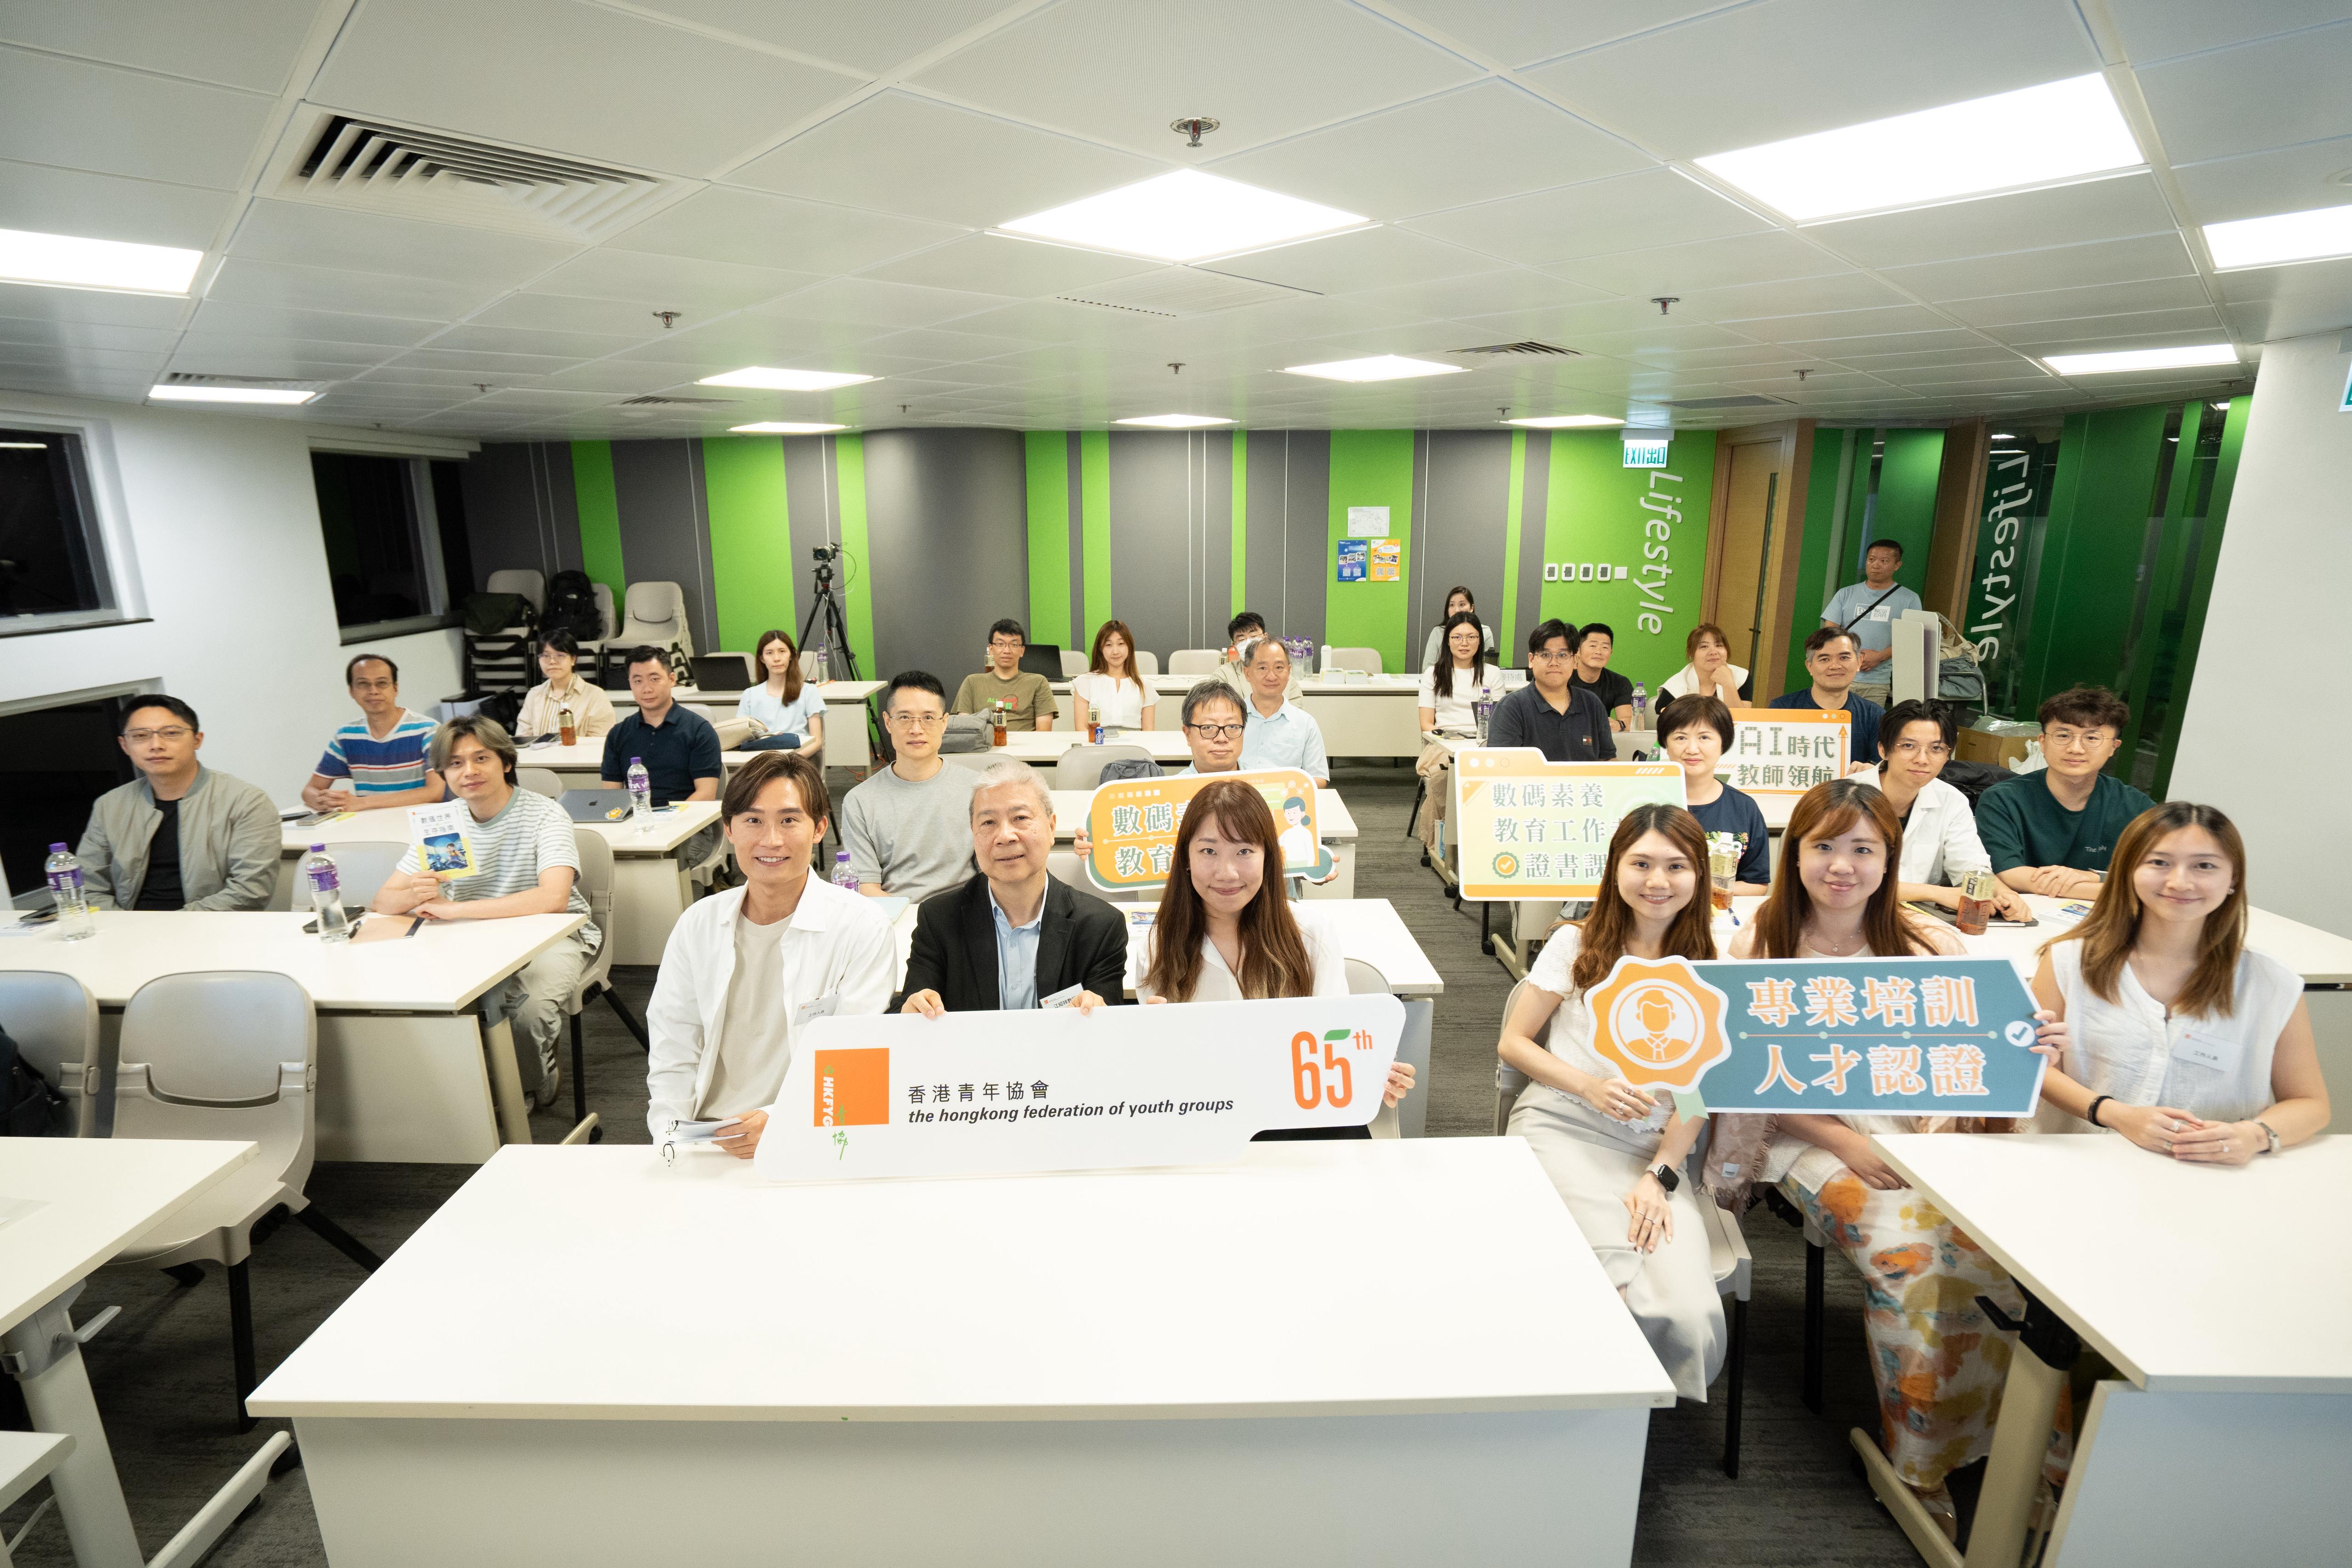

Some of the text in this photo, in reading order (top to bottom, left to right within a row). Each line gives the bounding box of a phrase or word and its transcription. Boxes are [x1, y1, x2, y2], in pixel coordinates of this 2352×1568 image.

[1625, 447, 1646, 464] EXIT
[1647, 447, 1666, 464] 出口
[1634, 471, 1683, 634] Lifestyle
[1740, 726, 1836, 758] AI時代
[1493, 783, 1604, 808] 數碼素養
[1494, 818, 1622, 843] 教育工作
[1746, 976, 1979, 1028] 專業培訓
[1754, 1043, 1990, 1096] 人才認證
[908, 1080, 1049, 1104] 香港青年協會
[909, 1100, 1234, 1124] the hongkong federation of youth groups
